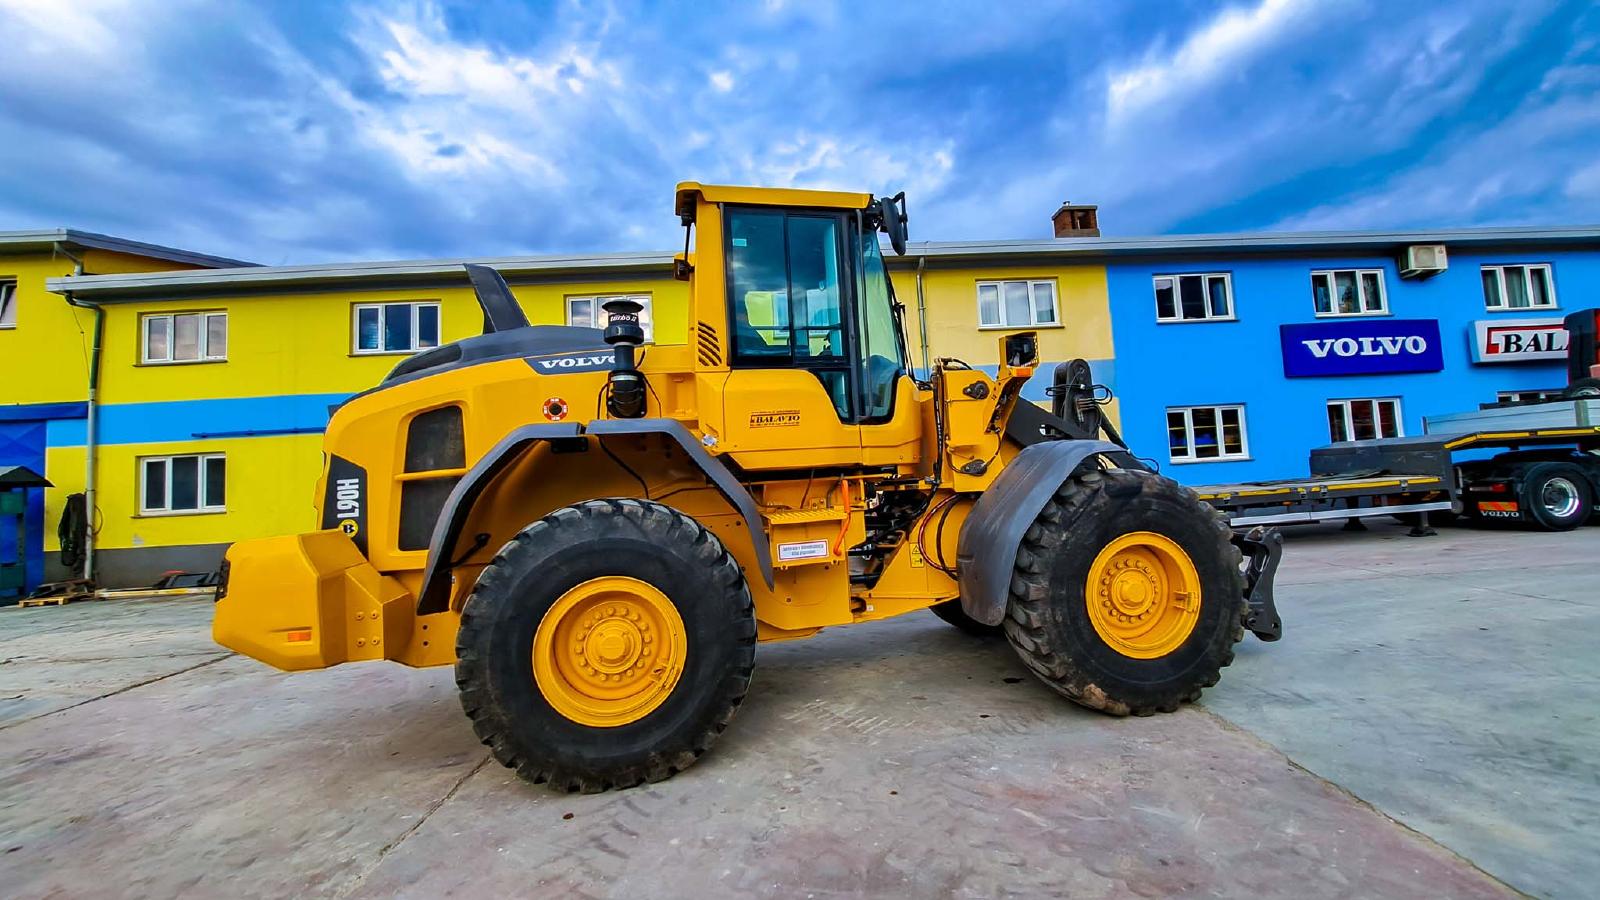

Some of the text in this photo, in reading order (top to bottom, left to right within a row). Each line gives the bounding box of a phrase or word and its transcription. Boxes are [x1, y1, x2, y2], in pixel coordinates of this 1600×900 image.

[1302, 335, 1427, 358] VOLVO
[1501, 332, 1569, 353] BAL
[336, 478, 360, 519] L90H
[1480, 510, 1520, 518] VOLVO
